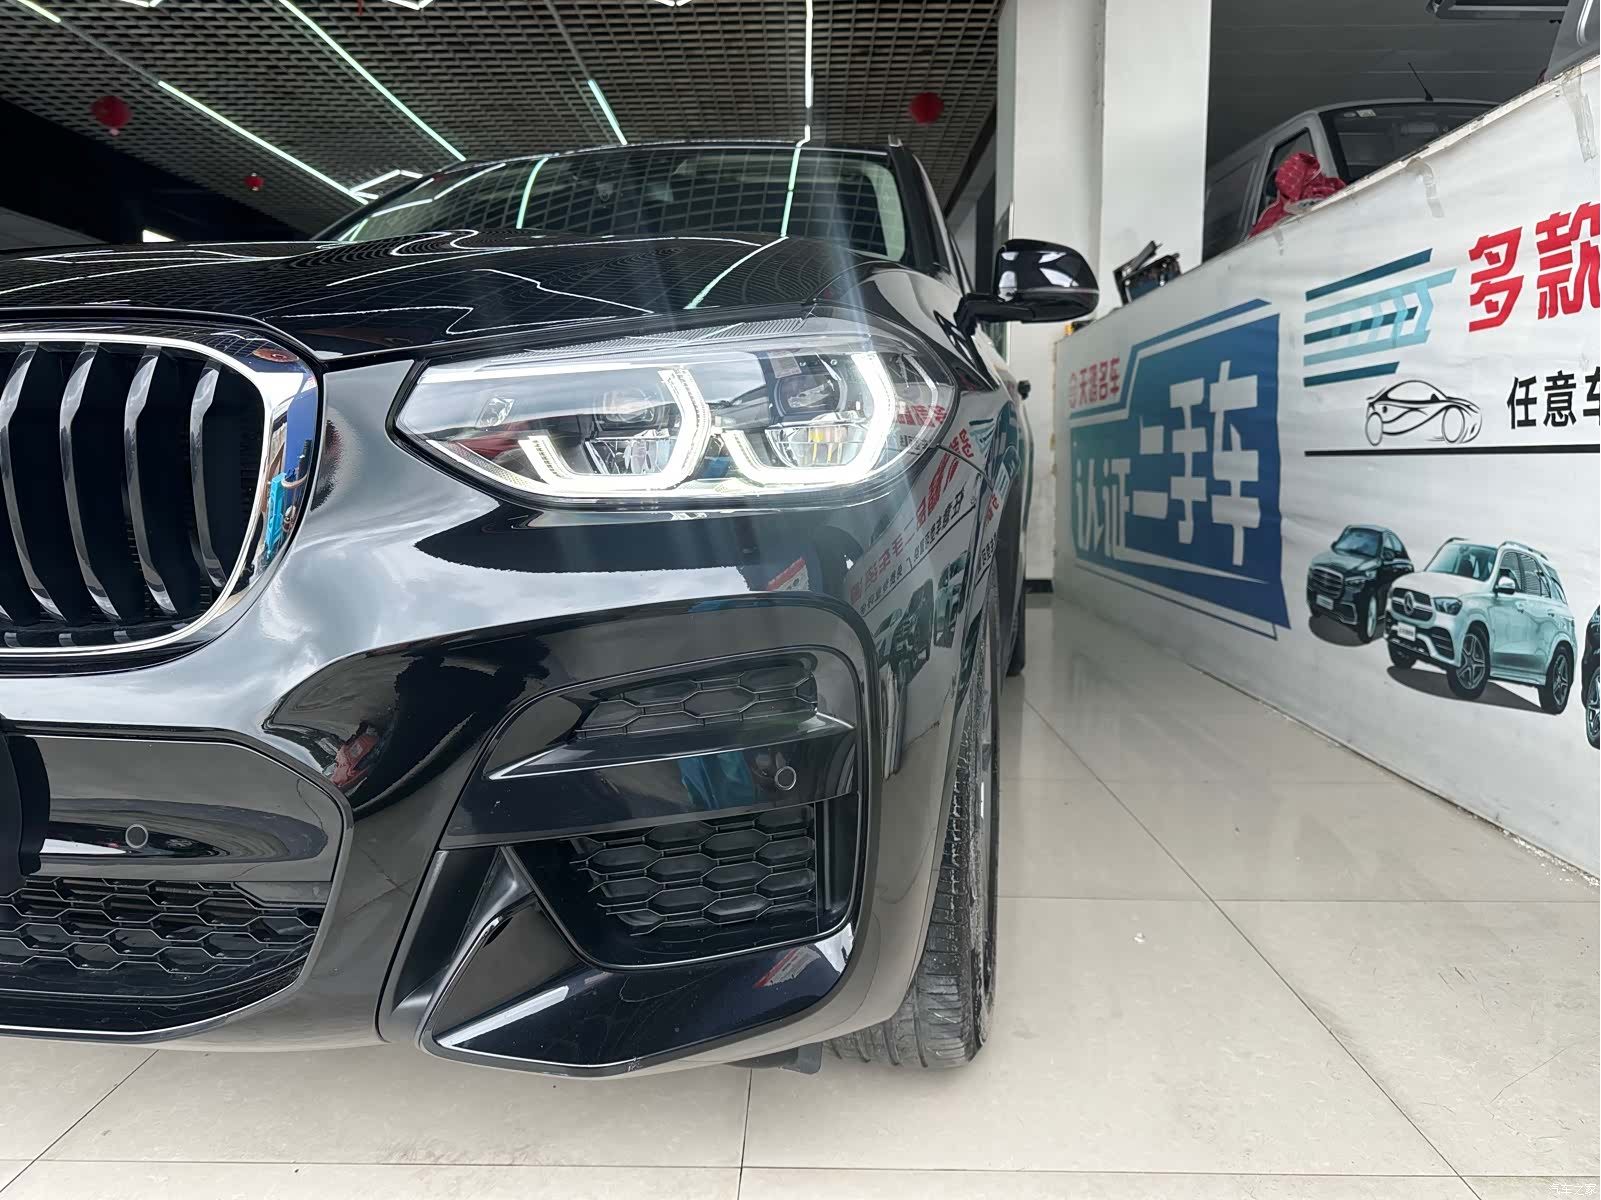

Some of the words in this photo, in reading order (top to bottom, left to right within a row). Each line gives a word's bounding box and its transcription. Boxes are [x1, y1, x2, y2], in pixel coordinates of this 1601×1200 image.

[1469, 202, 1600, 332] 多款
[1132, 360, 1261, 566] 二手车
